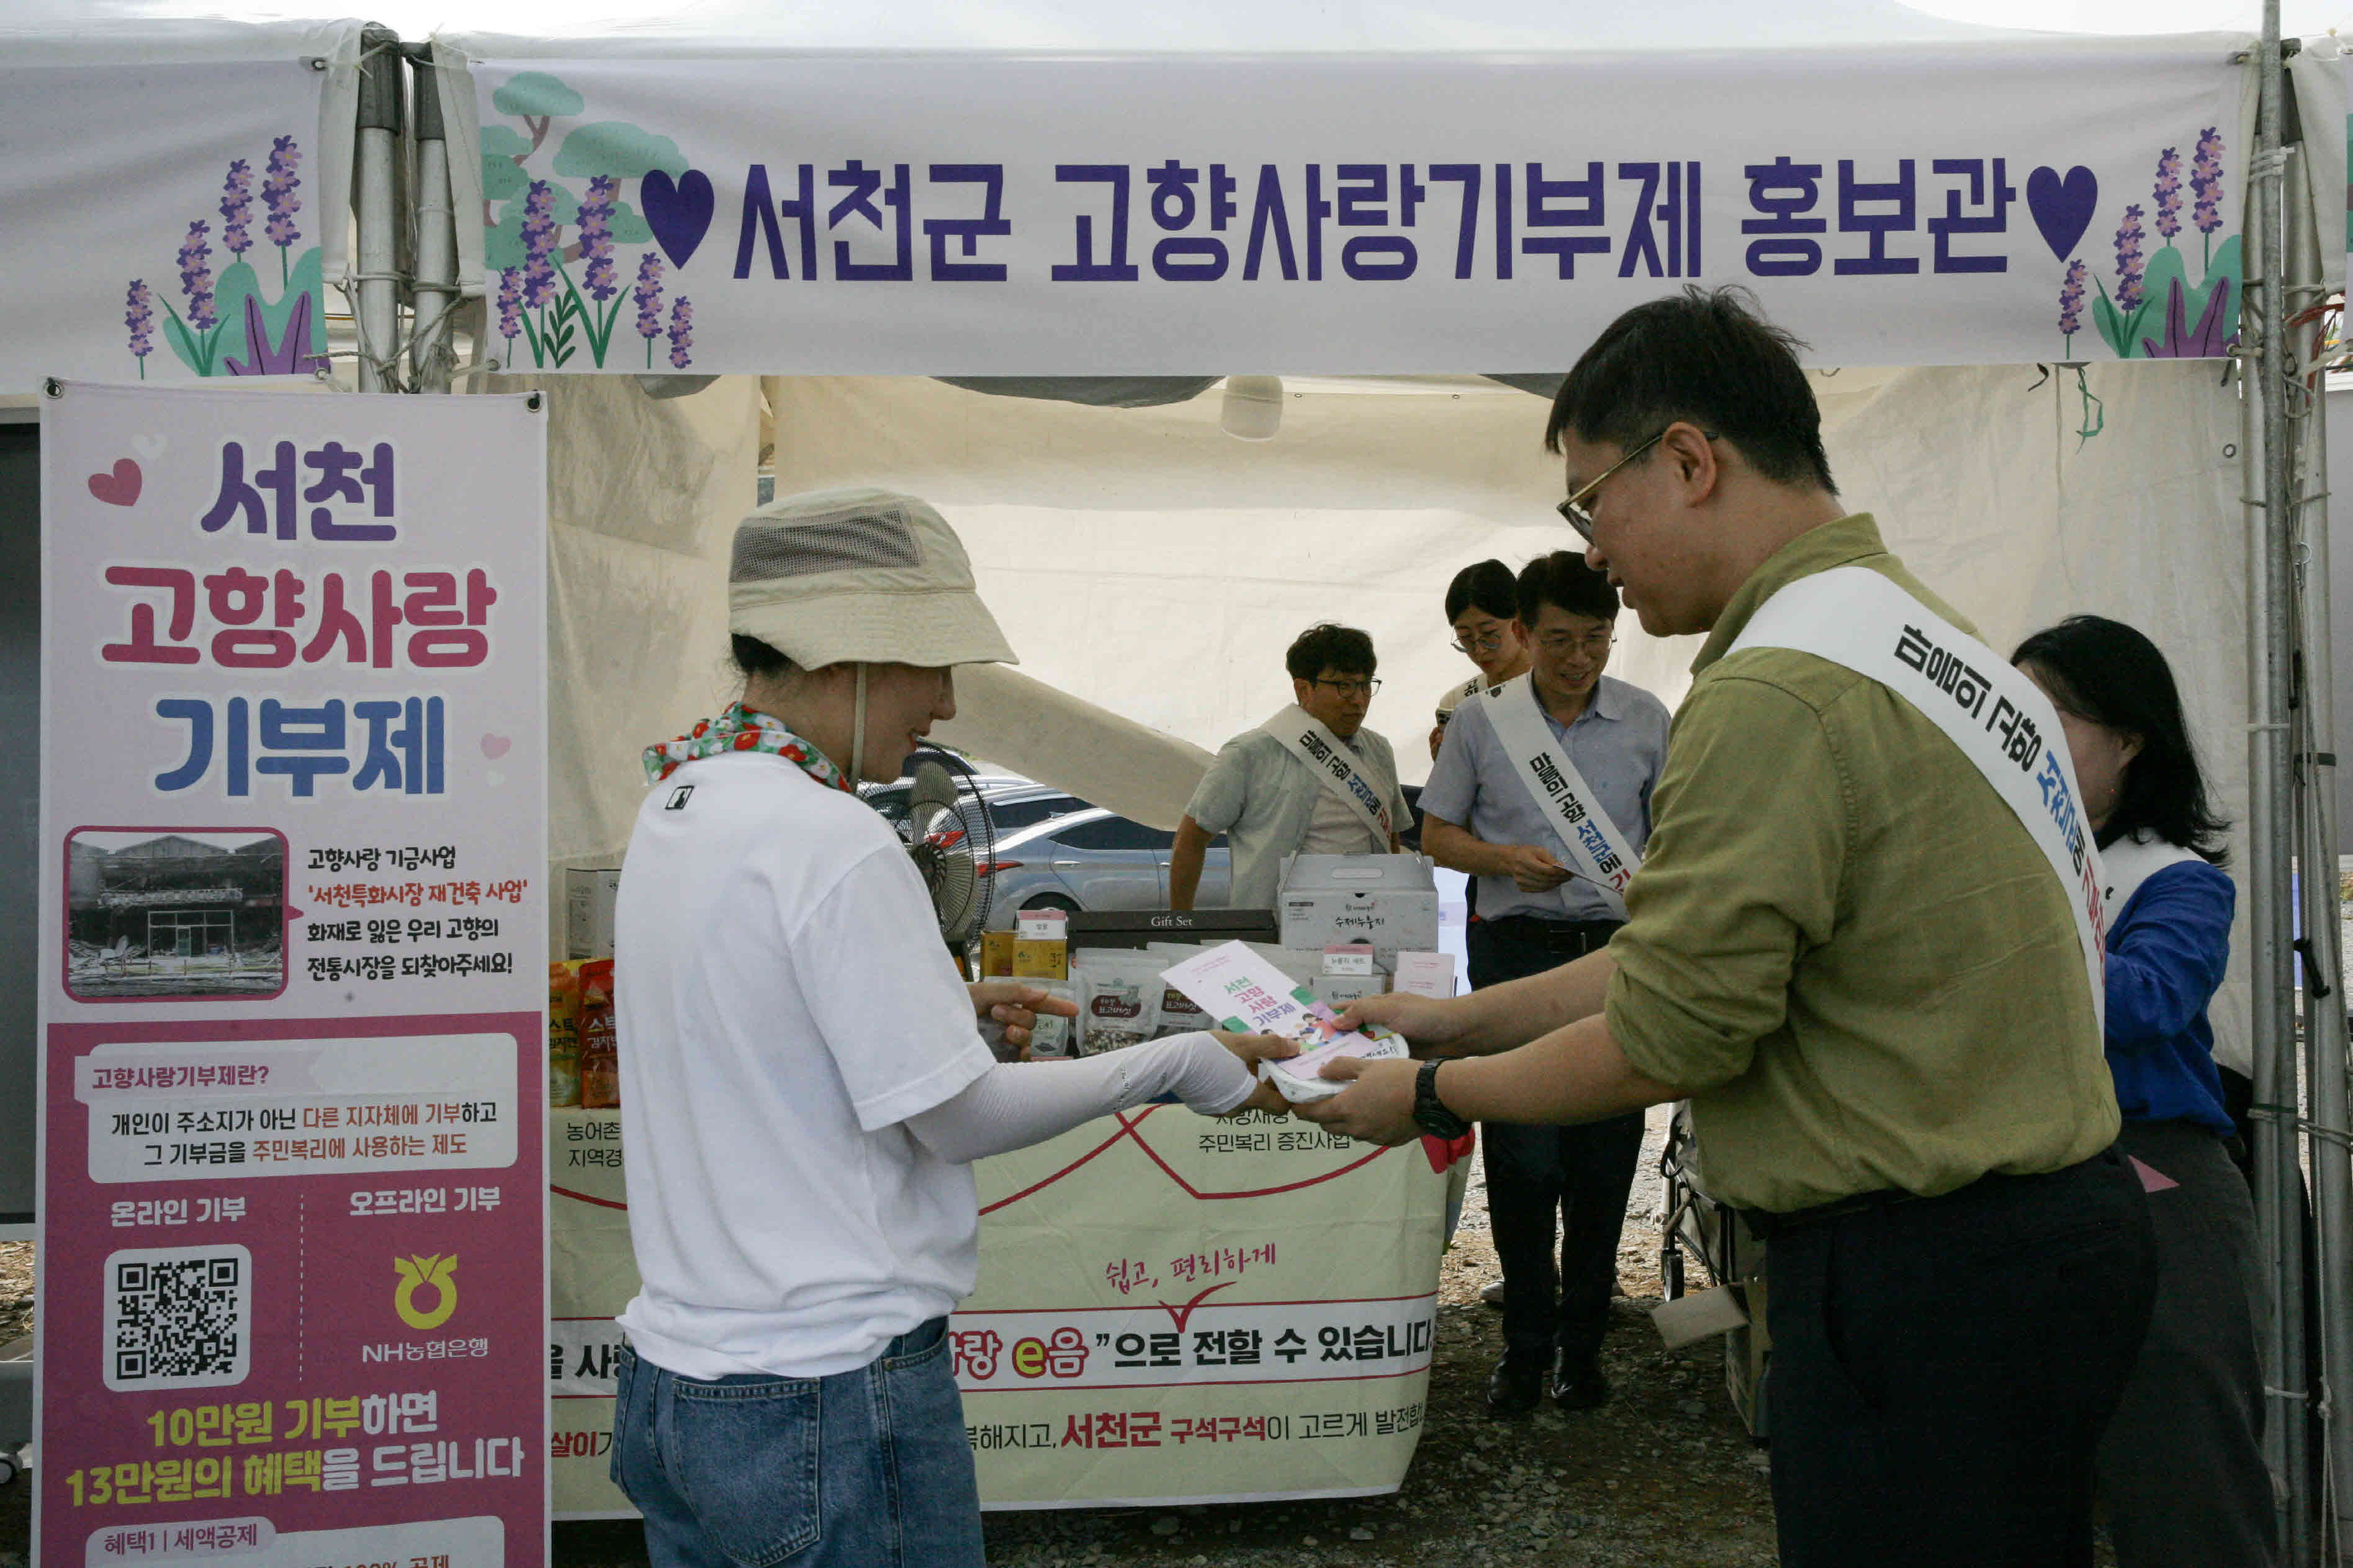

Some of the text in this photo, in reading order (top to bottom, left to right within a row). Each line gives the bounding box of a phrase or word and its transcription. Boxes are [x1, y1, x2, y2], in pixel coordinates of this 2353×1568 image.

[733, 156, 2016, 281] 서천군 고향사랑기부제 홍보관
[200, 440, 397, 542] 서천
[101, 566, 497, 669] 고향사랑
[154, 695, 445, 797] 기부제
[1299, 730, 1333, 764] 마음의
[1325, 755, 1351, 781] 고향
[1894, 623, 1992, 720] 마음의
[1985, 694, 2042, 773] 고향
[2036, 748, 2086, 877] 서천군에
[1529, 751, 1569, 797] 마음의
[1555, 792, 1586, 824] 고향
[1577, 818, 1623, 874] 서천군에
[307, 846, 456, 872] 고향사랑 기금사업
[428, 880, 481, 905] 재건축
[307, 916, 498, 944] 화재로 잃은 우리 고향의
[1151, 916, 1192, 927] Gift Set
[1335, 914, 1385, 930] 수제누룽지
[307, 952, 513, 982] 전통시장을 되찾아주세요!
[1253, 1001, 1297, 1027] 기부제
[91, 1065, 270, 1090] 고향사랑기부제란?
[111, 1101, 497, 1136] 개인이 주소지가 아닌 다른 지자체에 기부하고
[567, 1122, 621, 1141] 농어촌
[143, 1132, 467, 1167] 그 기부금을 주민복리에 사용하는 제도
[569, 1149, 622, 1167] 지역경
[1199, 1131, 1350, 1153] 주민복리 증진사업
[110, 1196, 247, 1228] 온라인 기부
[349, 1186, 502, 1218] 오프라인 기부
[1106, 1242, 1275, 1295] 쉽고, 편리하게
[362, 1337, 489, 1364] NH농협은행
[1192, 1328, 1262, 1366] 전할
[1274, 1328, 1307, 1364] 수
[146, 1389, 438, 1447] 10만원 기부하면
[1061, 1412, 1162, 1449] 서천군
[1171, 1415, 1290, 1445] 구석구석이
[1298, 1410, 1368, 1440] 고르게
[65, 1436, 525, 1507] 13만원의 혜택을 드립니다
[104, 1523, 258, 1556] 혜택1 세액공제
